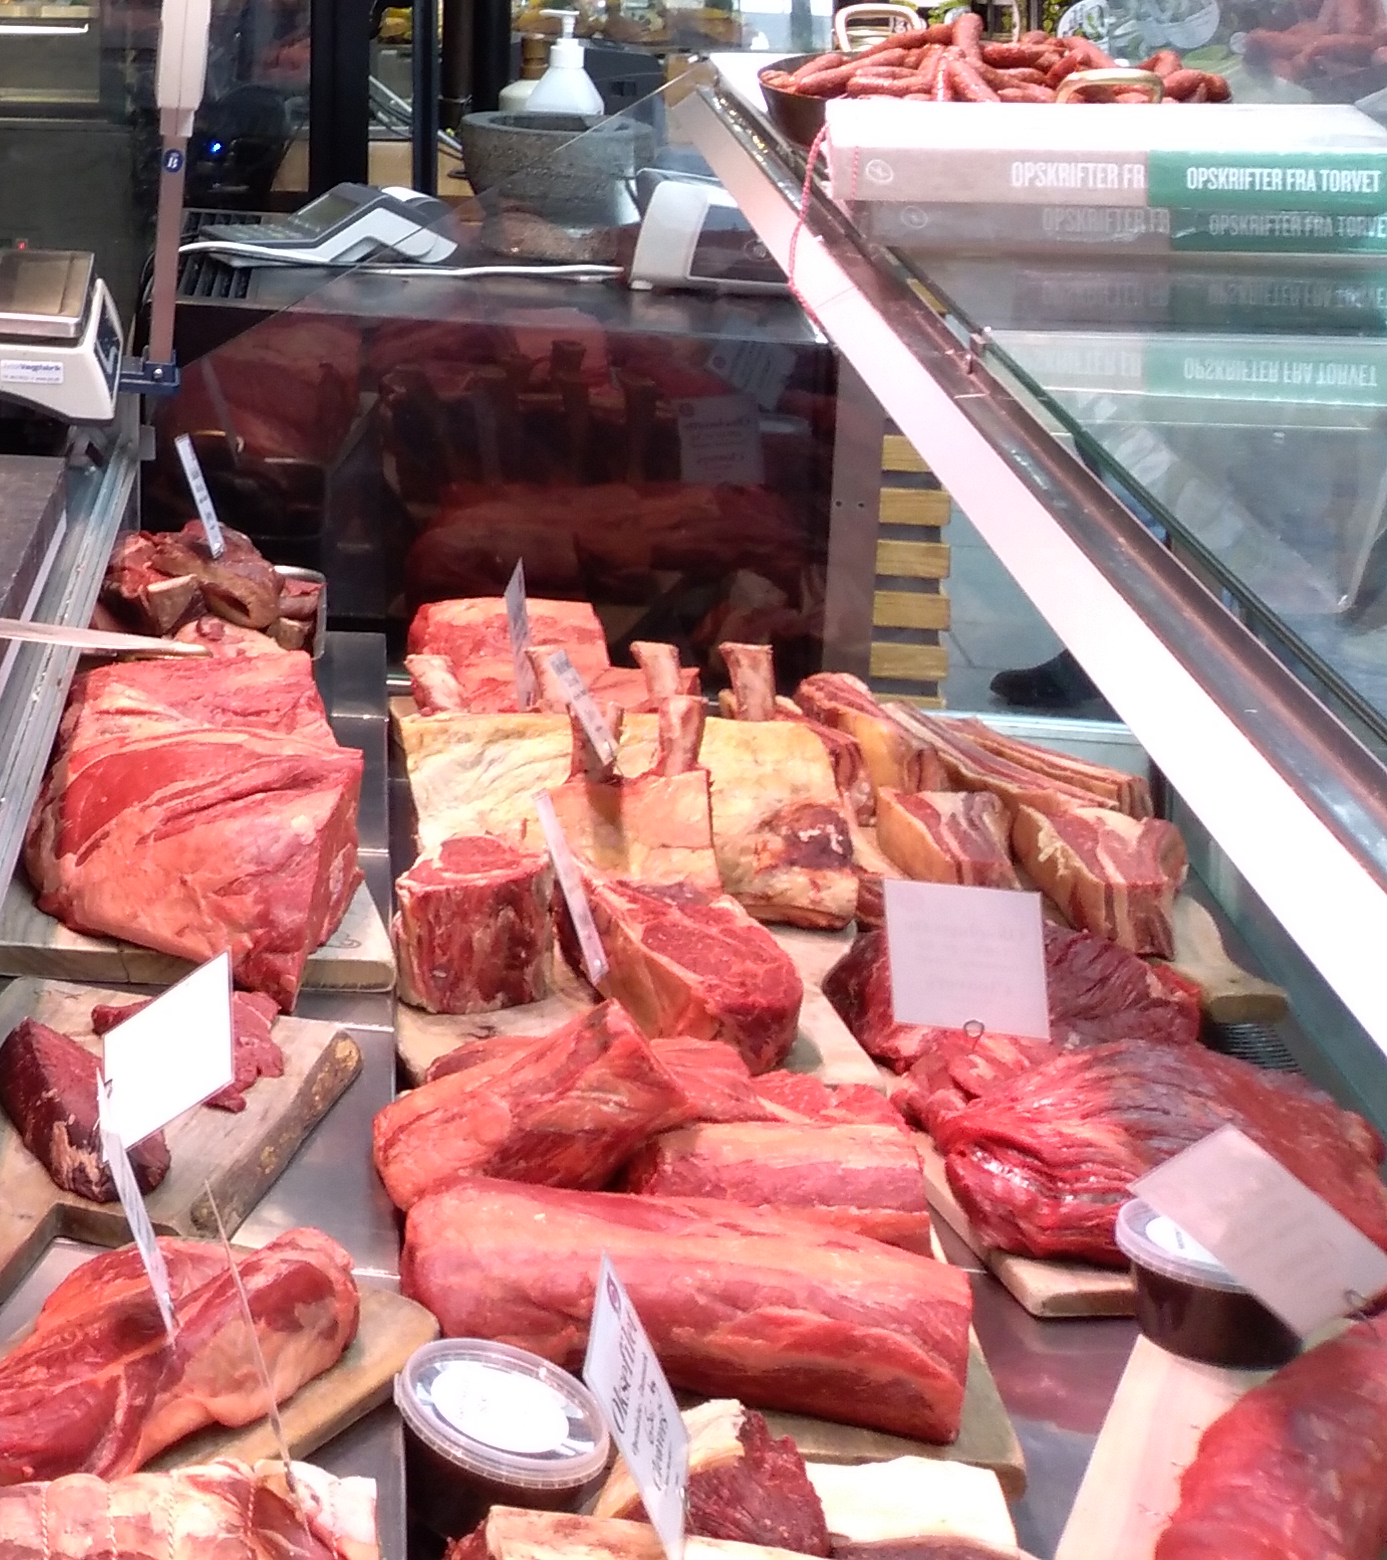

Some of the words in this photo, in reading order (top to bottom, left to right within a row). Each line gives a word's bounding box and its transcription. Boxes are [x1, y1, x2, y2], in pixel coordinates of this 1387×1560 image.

[1011, 160, 1119, 189] OPSKRIFTER
[1185, 166, 1282, 191] OPSKRIFTER
[1287, 168, 1317, 192] FRA
[1320, 169, 1382, 193] TORVET
